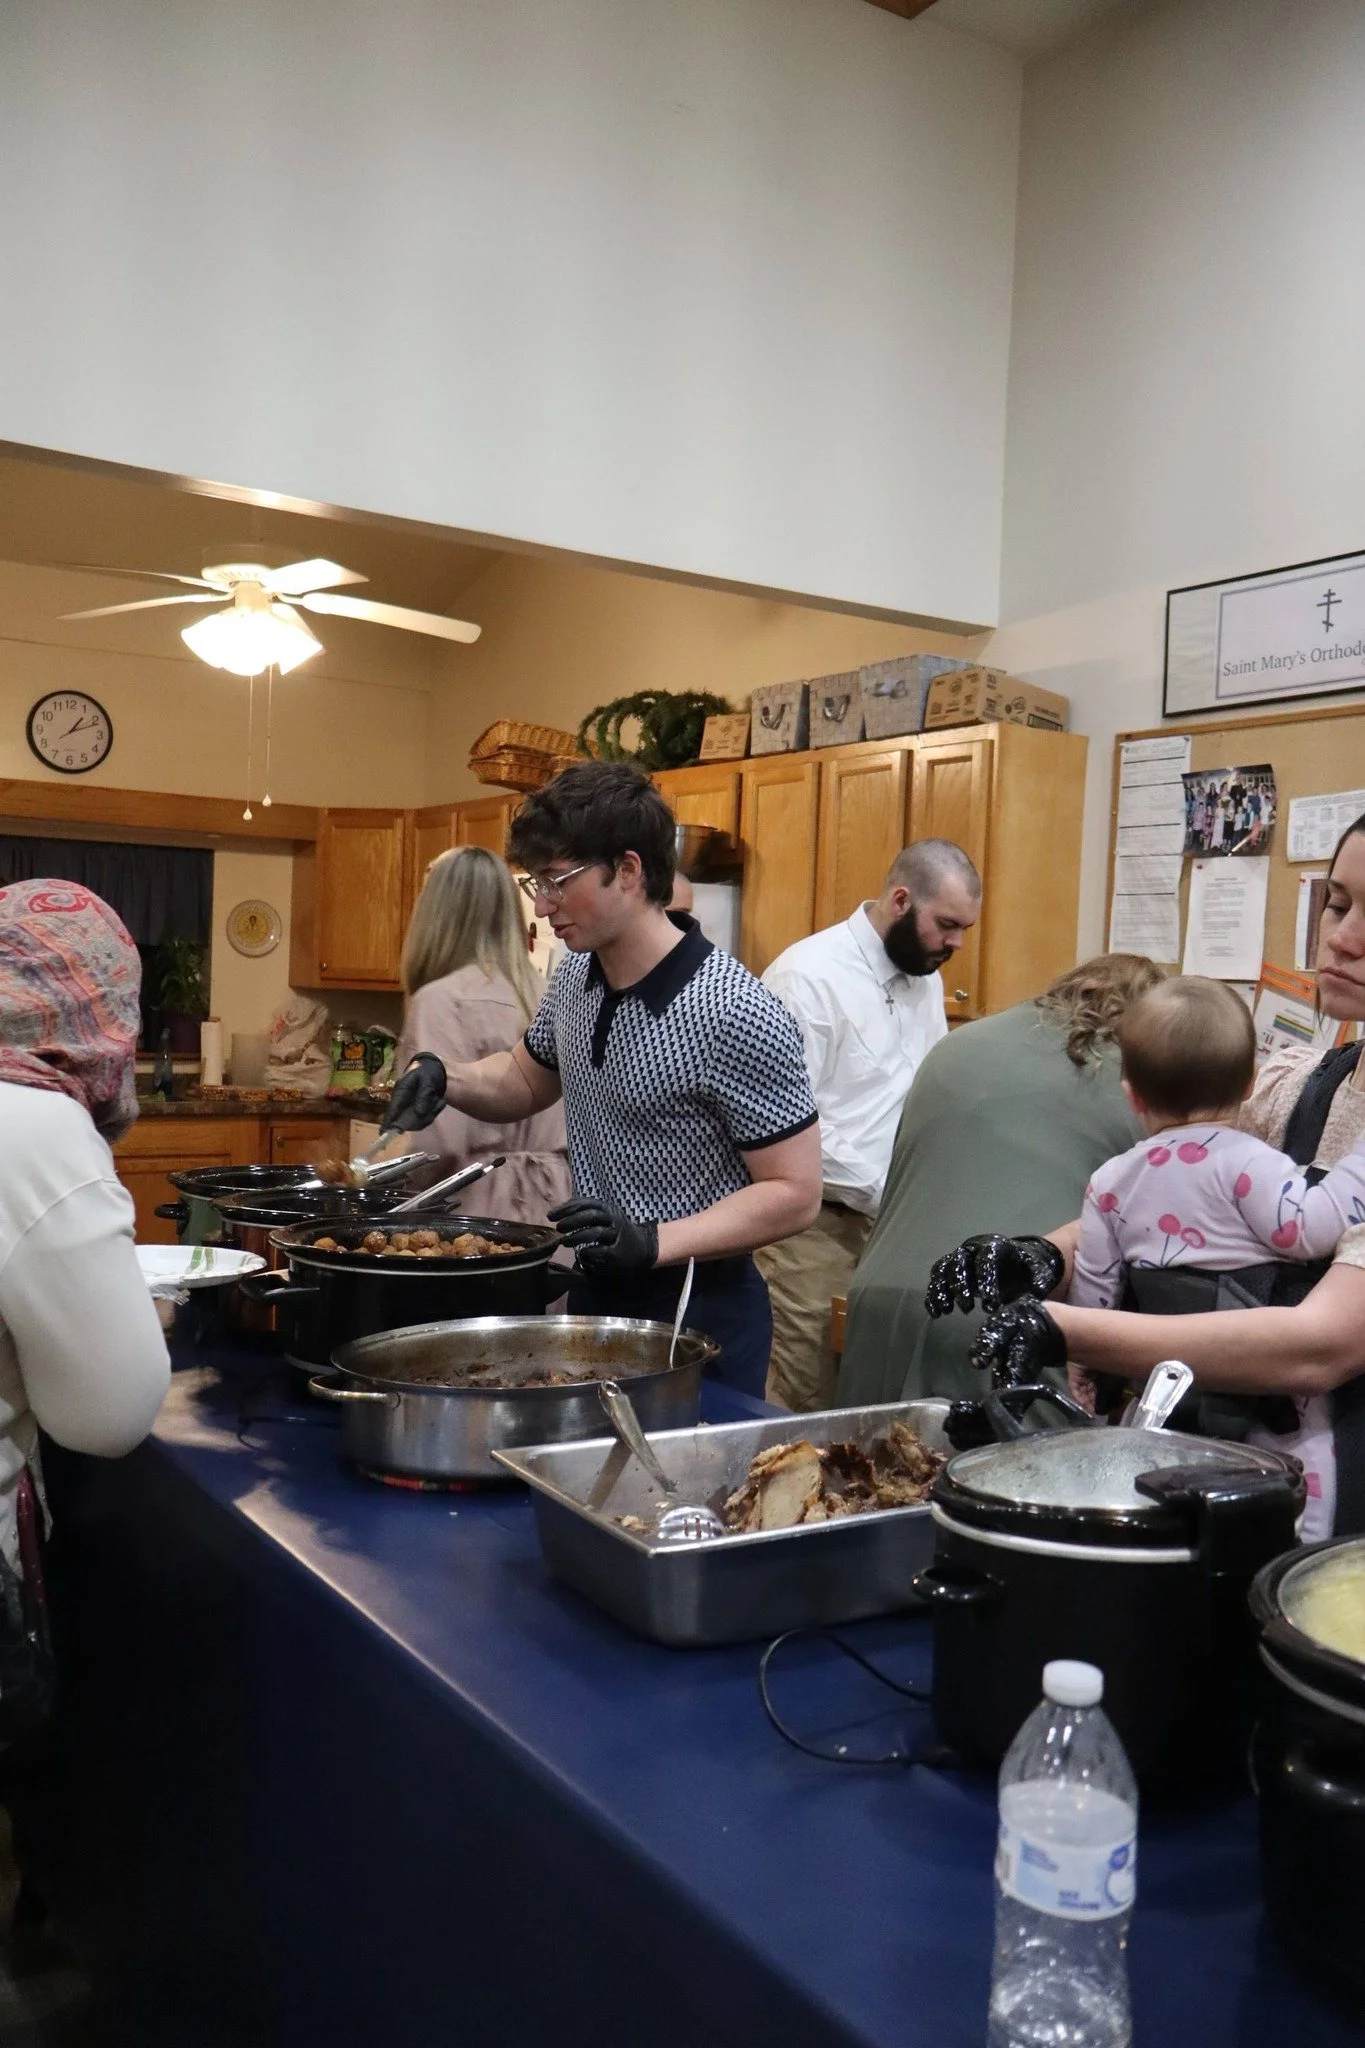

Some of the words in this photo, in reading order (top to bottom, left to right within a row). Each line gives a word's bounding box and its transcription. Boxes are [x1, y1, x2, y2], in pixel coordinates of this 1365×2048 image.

[1223, 660, 1256, 677] Saint
[1261, 651, 1306, 671] Mary's
[52, 701, 62, 711] 11
[65, 699, 77, 710] 12
[82, 704, 87, 714] 1
[41, 710, 53, 721] 10
[92, 715, 99, 725] 2
[36, 724, 43, 735] 9
[96, 730, 103, 740] 3
[40, 738, 48, 748] 8
[92, 744, 99, 753] 4
[52, 749, 59, 759] 7
[80, 753, 88, 763] 5
[65, 755, 73, 765] 6
